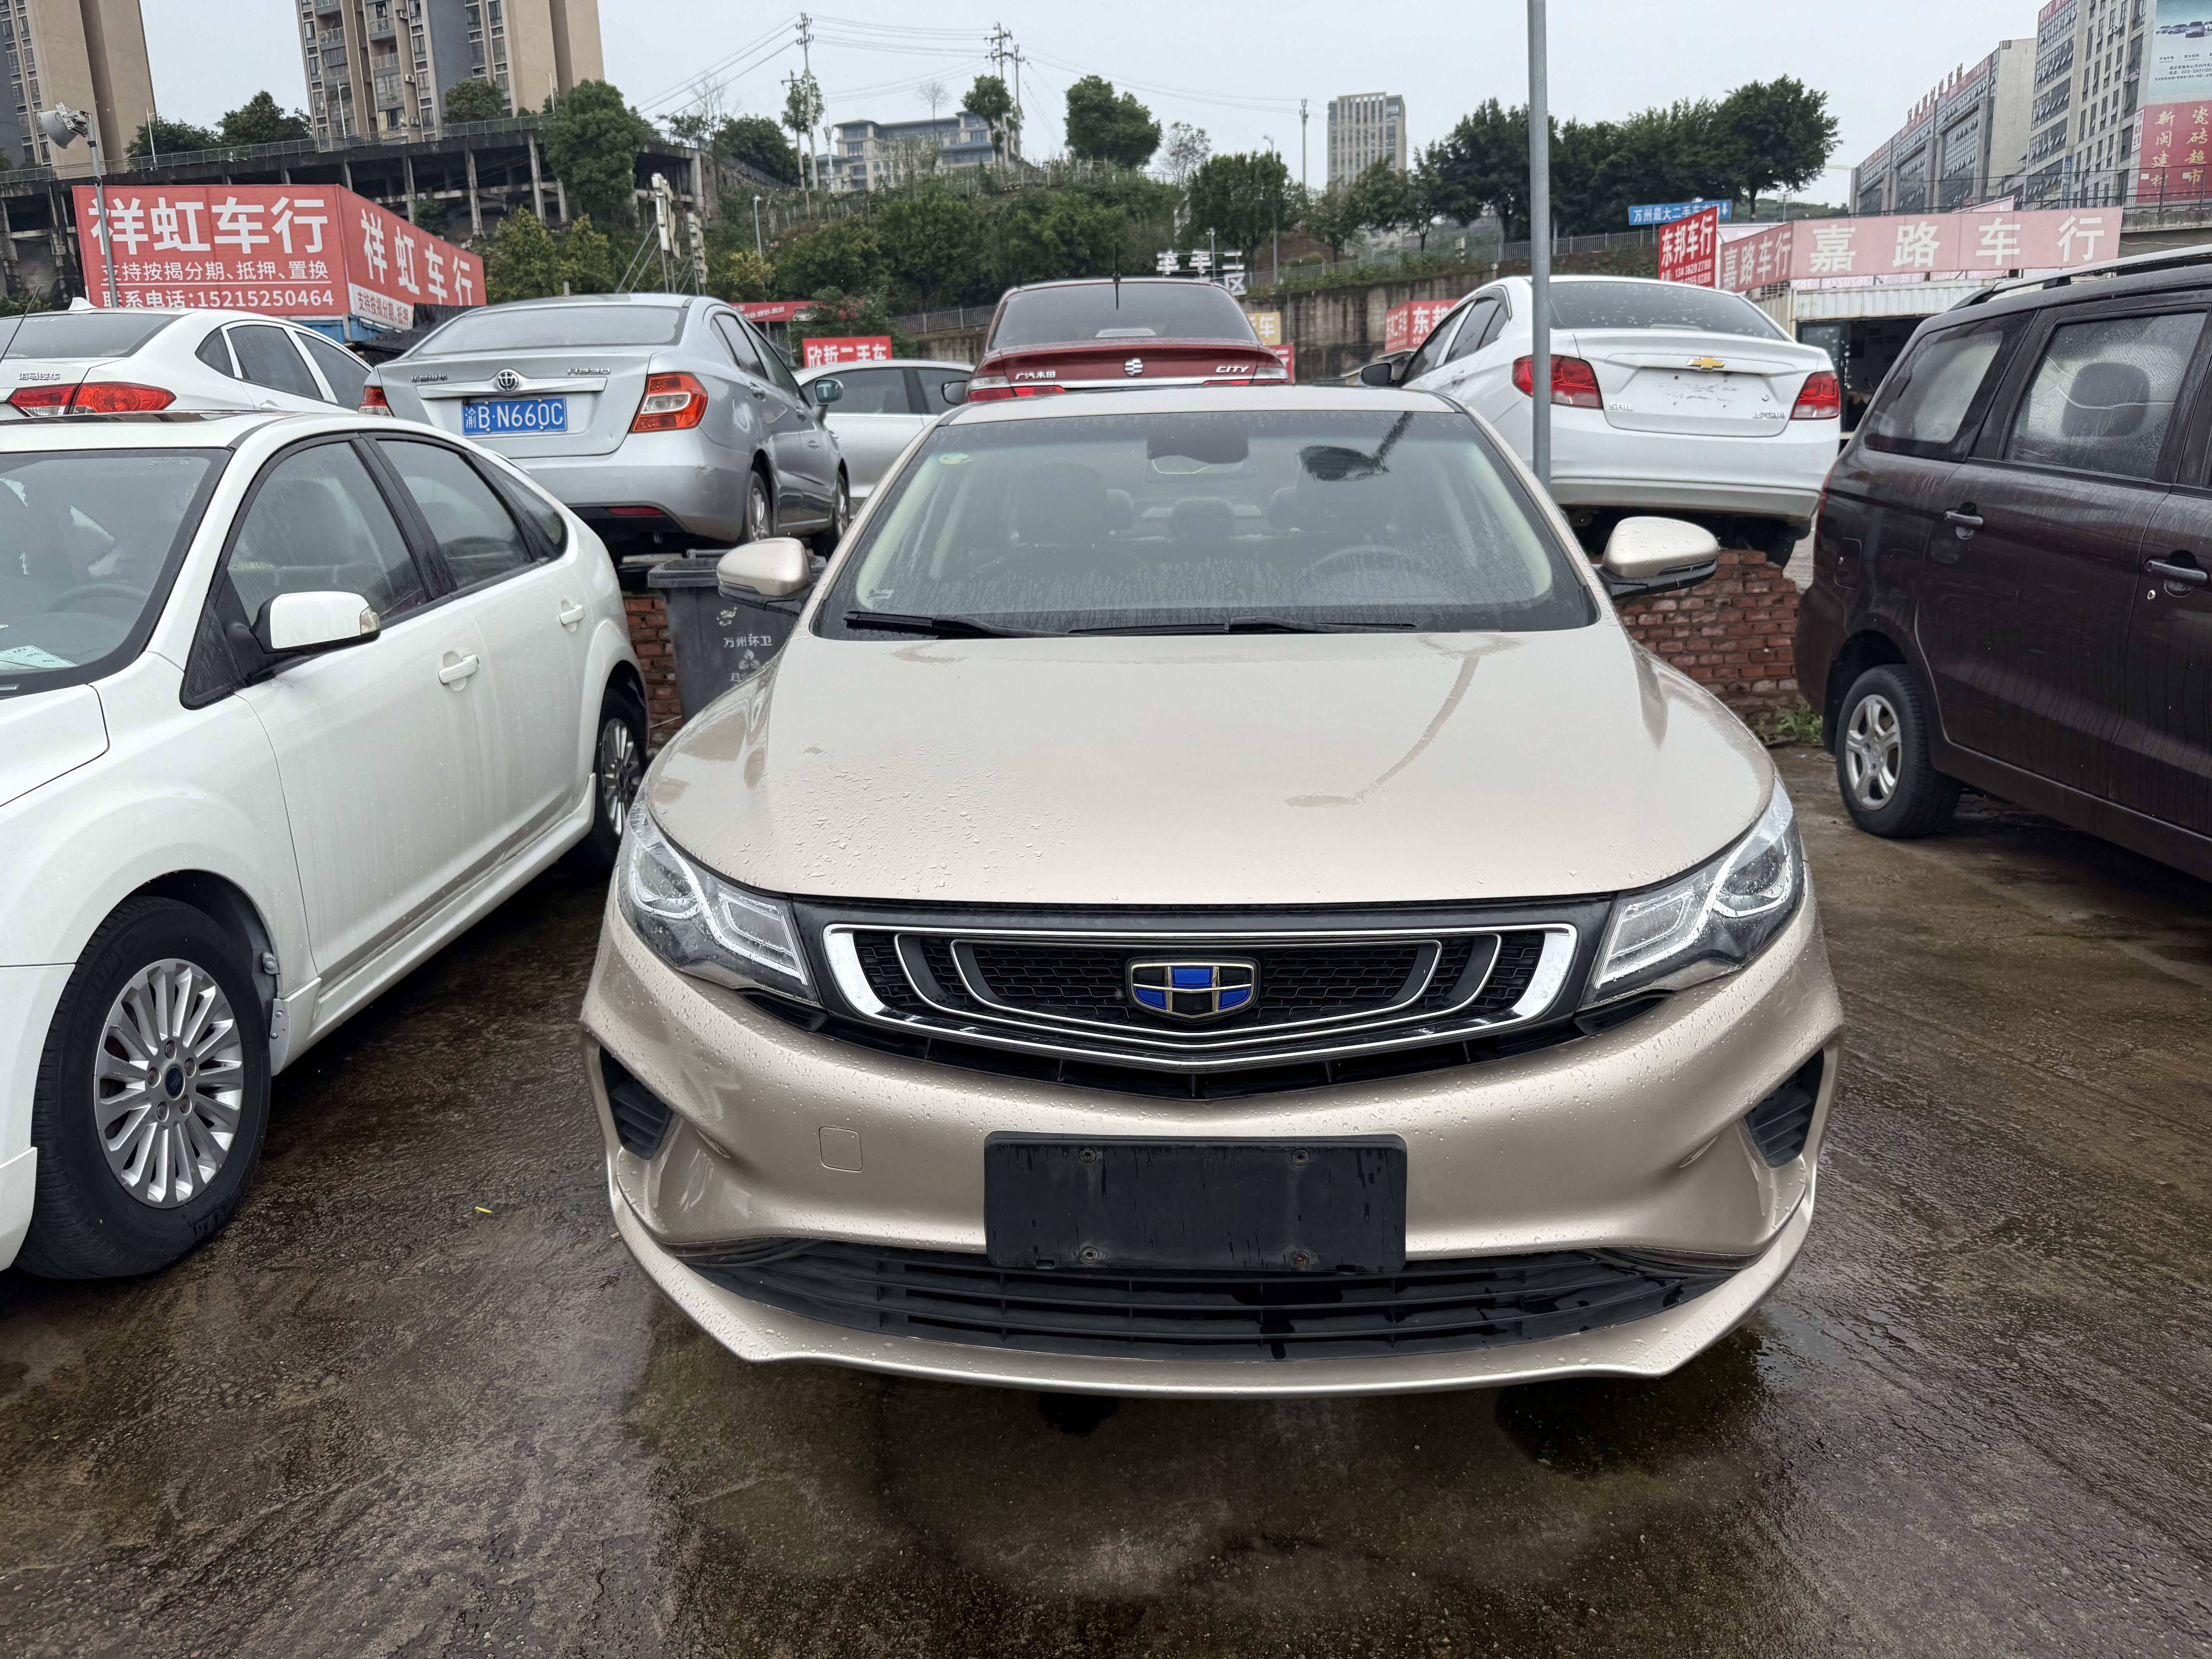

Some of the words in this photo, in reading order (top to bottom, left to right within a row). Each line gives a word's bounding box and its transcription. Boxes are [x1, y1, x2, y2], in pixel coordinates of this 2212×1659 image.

[88, 196, 328, 255] 祥虹车行
[1661, 214, 1713, 267] 东邦车行
[1809, 215, 2105, 273] 嘉路车行
[361, 208, 472, 306] 祥虹车行
[1722, 231, 1791, 290] 嘉路车行
[1015, 370, 1056, 380] 广汽本田
[1609, 402, 1633, 412] SAIL
[723, 634, 772, 648] 万州环卫
